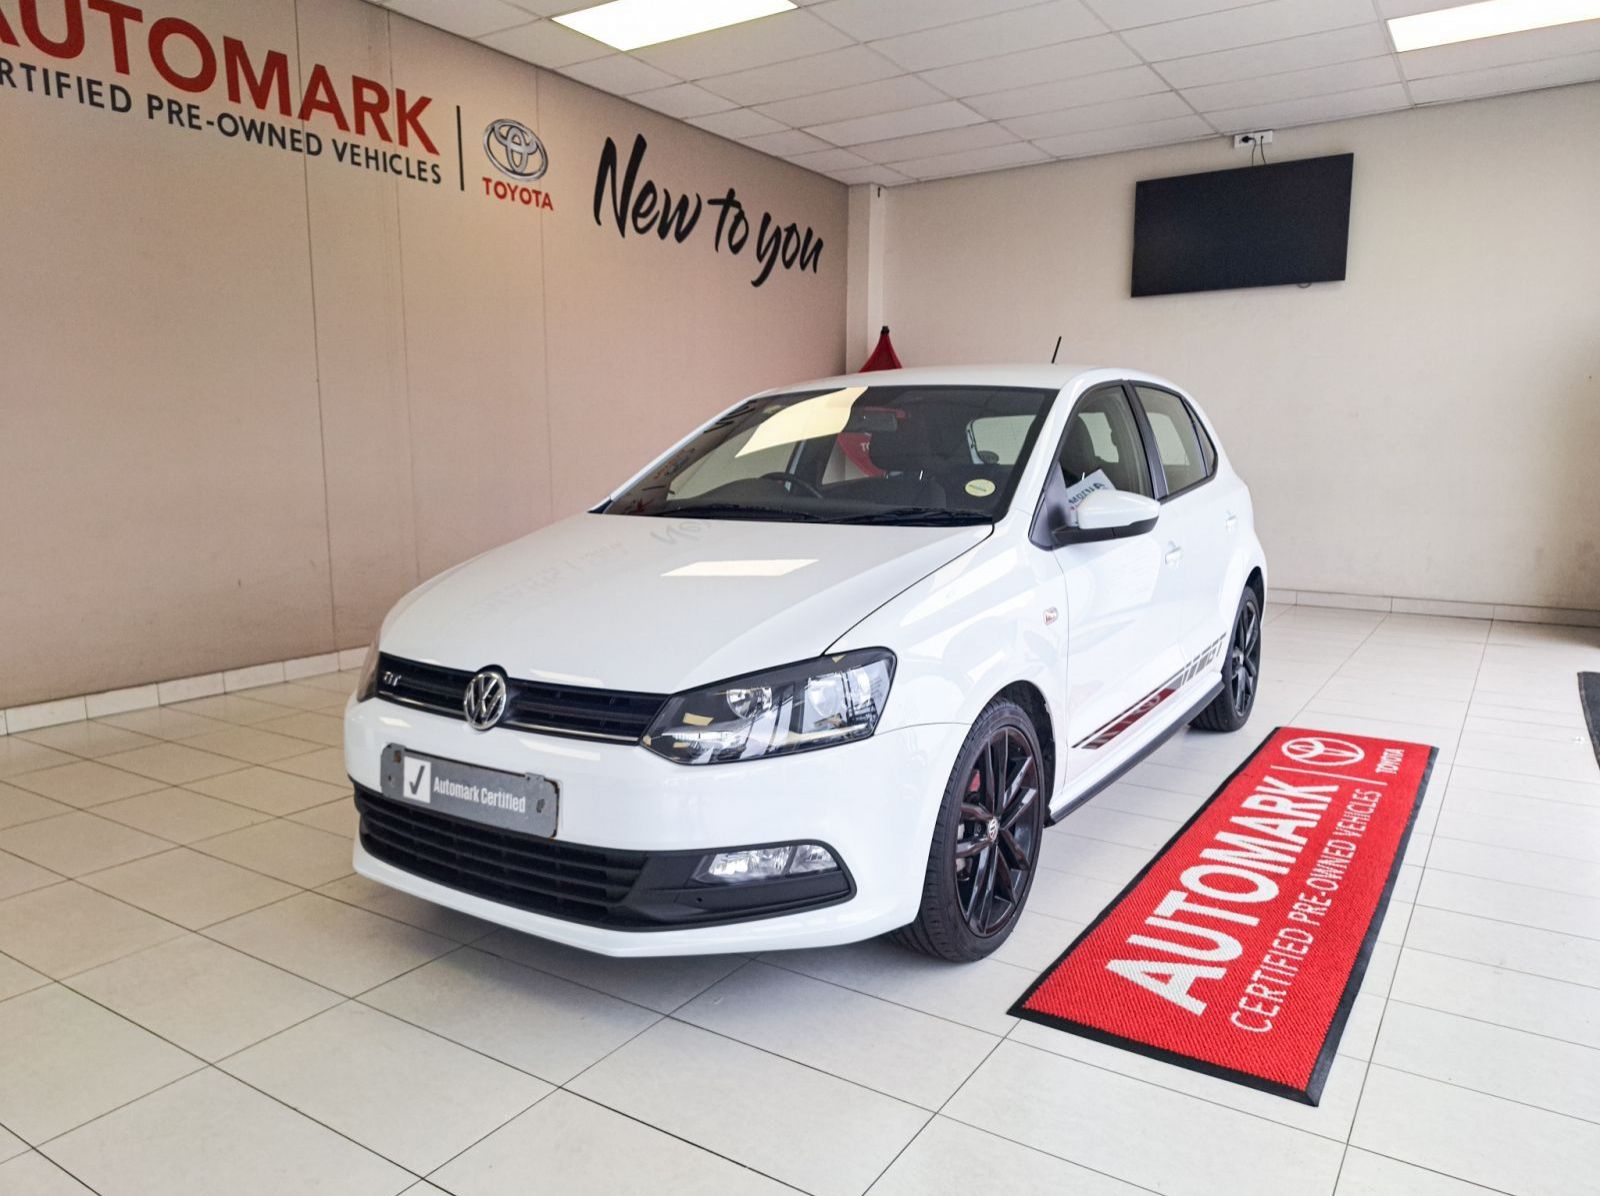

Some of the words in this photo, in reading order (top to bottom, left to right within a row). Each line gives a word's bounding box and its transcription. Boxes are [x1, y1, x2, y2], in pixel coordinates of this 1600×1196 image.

[0, 0, 440, 156] UTOMARK
[147, 93, 323, 157] PRE-OWNED
[332, 139, 442, 184] VEHICLES
[482, 177, 554, 211] TOYOTA
[593, 133, 702, 243] New
[707, 188, 749, 255] to
[751, 212, 824, 287] you
[433, 776, 480, 803] Automark
[481, 787, 526, 813] Certified
[1375, 748, 1405, 775] TOYOTA
[1105, 775, 1339, 1016] AUTOMARK
[1230, 927, 1314, 1032] CERTIFIED
[1287, 839, 1357, 927] PRE-OWNED
[1333, 788, 1383, 838] VEHICLES
